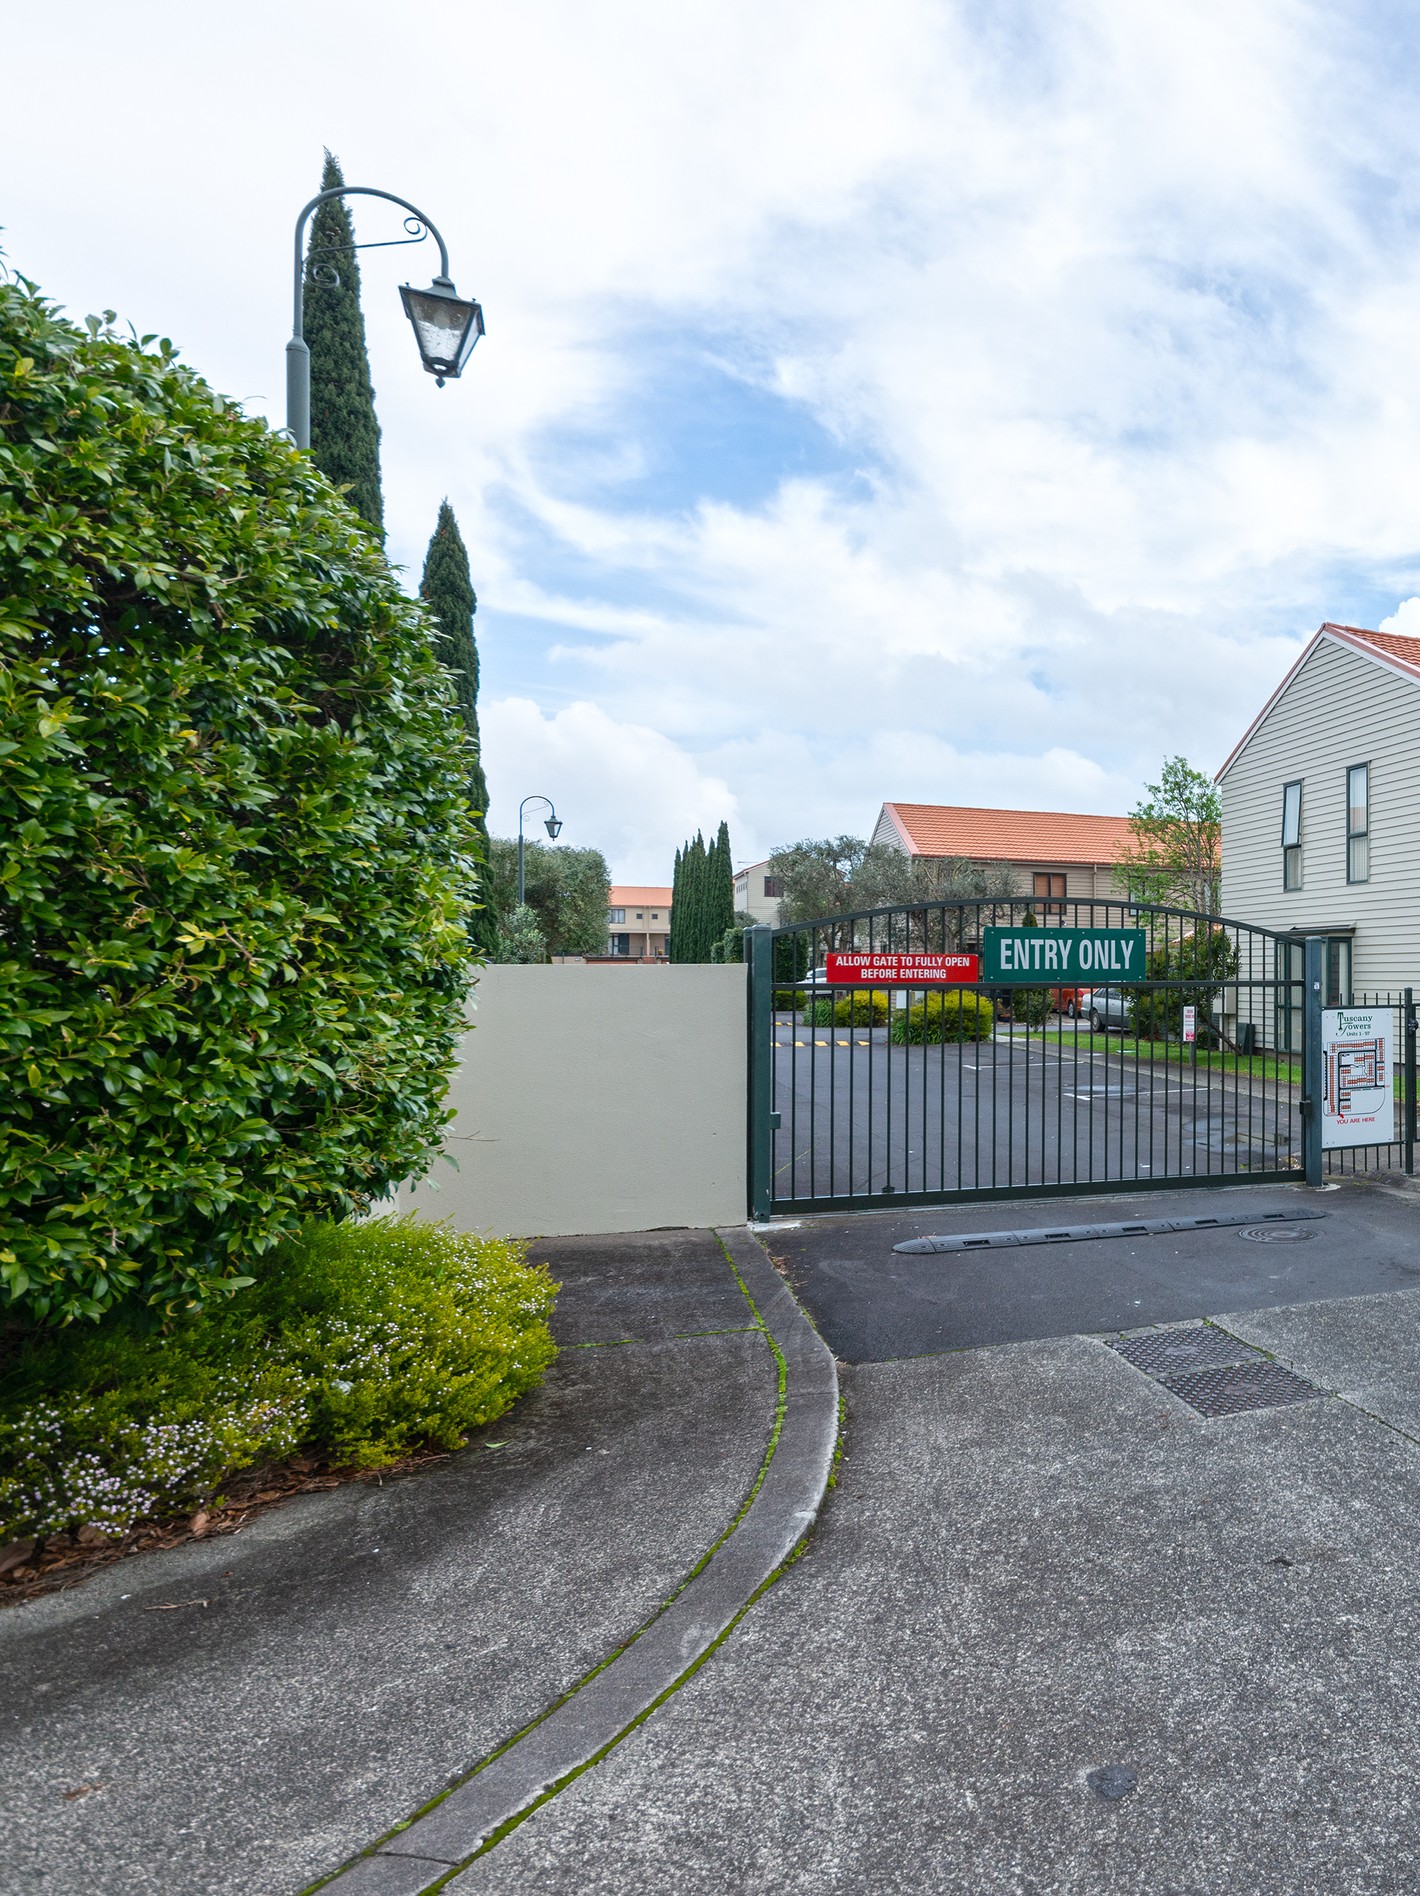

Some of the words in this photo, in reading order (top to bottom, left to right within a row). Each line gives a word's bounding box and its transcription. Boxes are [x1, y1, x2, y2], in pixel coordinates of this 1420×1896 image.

[836, 956, 870, 967] ALLOW
[873, 957, 898, 967] GATE
[900, 957, 913, 967] TO
[915, 957, 943, 967] FULLY
[945, 957, 970, 967] OPEN
[1000, 939, 1073, 970] ENTRY
[1079, 940, 1134, 970] ONLY
[861, 969, 898, 979] BEFORE
[900, 969, 946, 979] ENTERING
[1337, 1012, 1373, 1030] Tuscany
[1336, 1022, 1371, 1037] Towers
